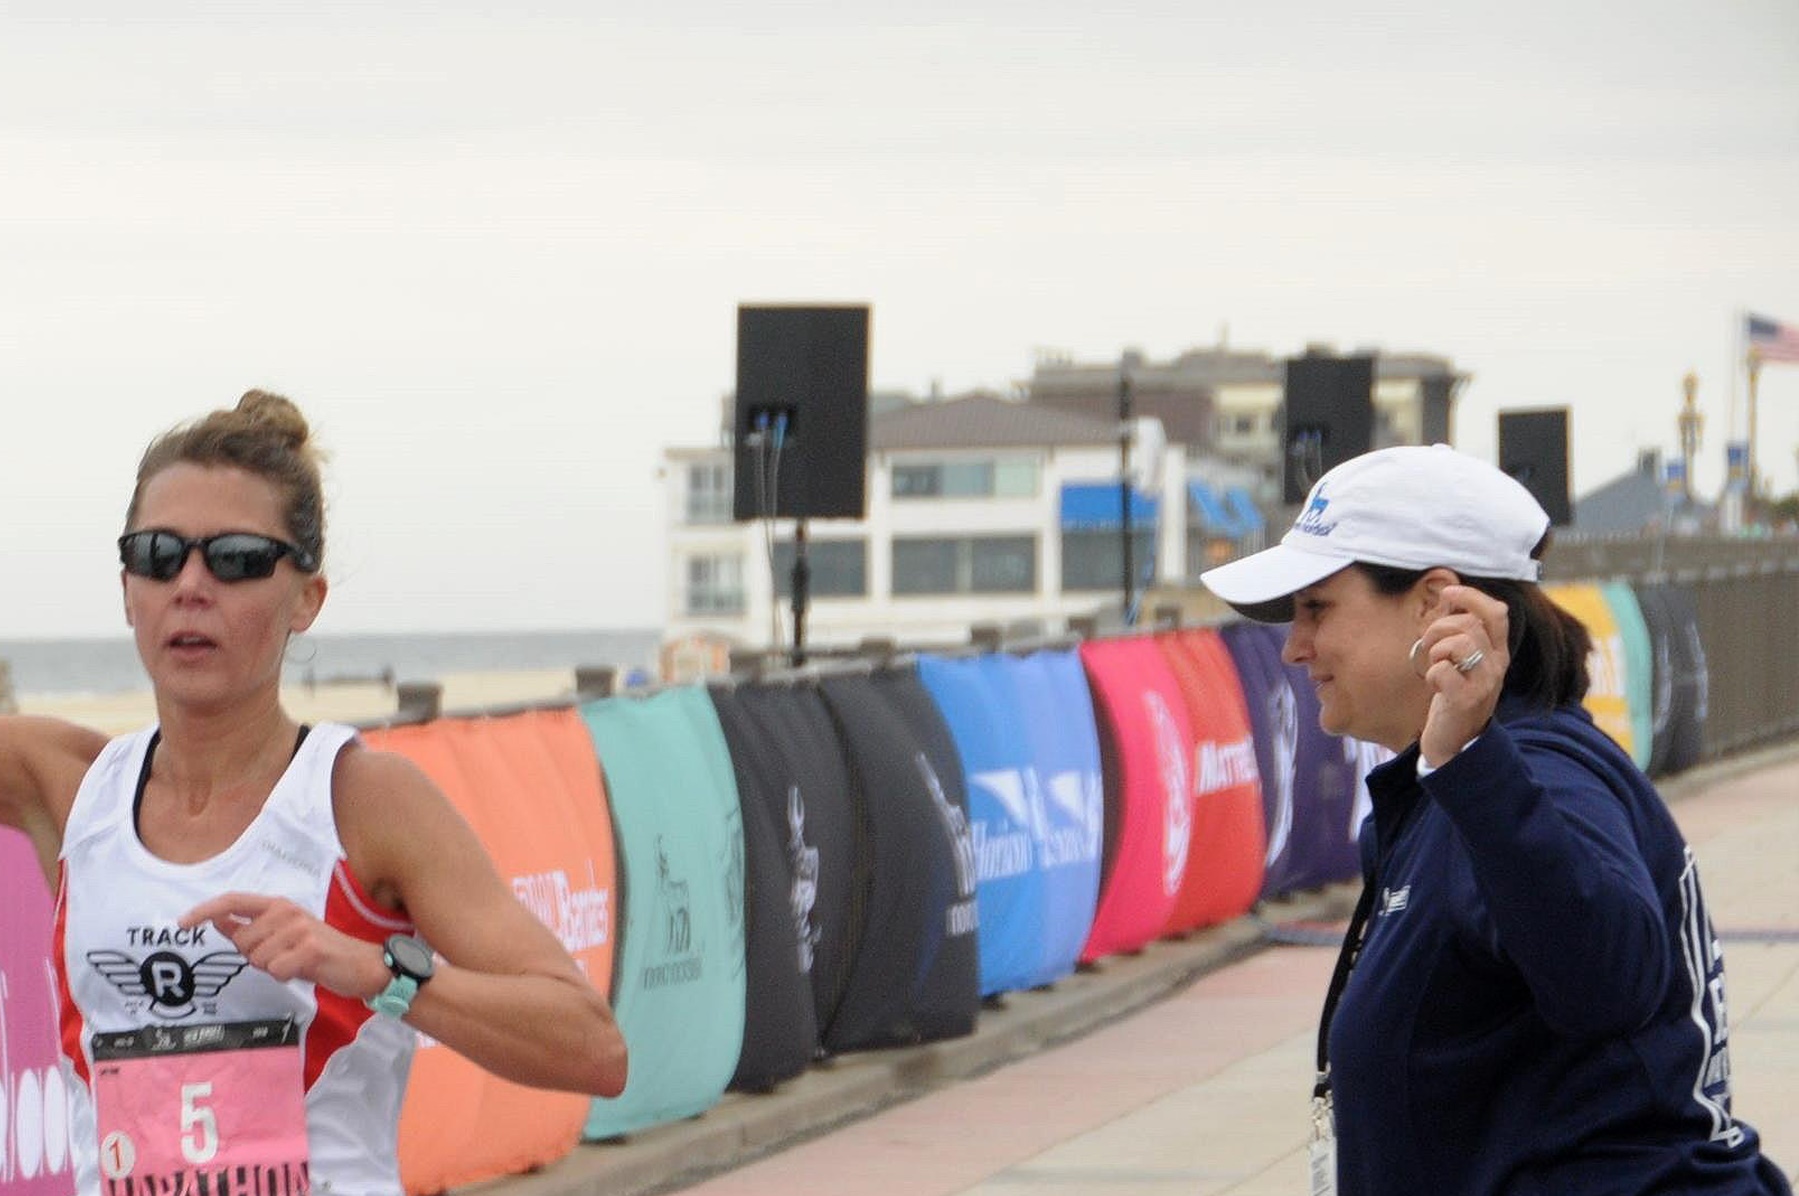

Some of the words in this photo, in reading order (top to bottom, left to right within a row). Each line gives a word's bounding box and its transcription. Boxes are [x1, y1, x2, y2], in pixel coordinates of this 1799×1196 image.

[127, 926, 206, 947] TRACK
[151, 961, 185, 998] R
[179, 1081, 219, 1164] 5
[109, 1139, 122, 1172] 1
